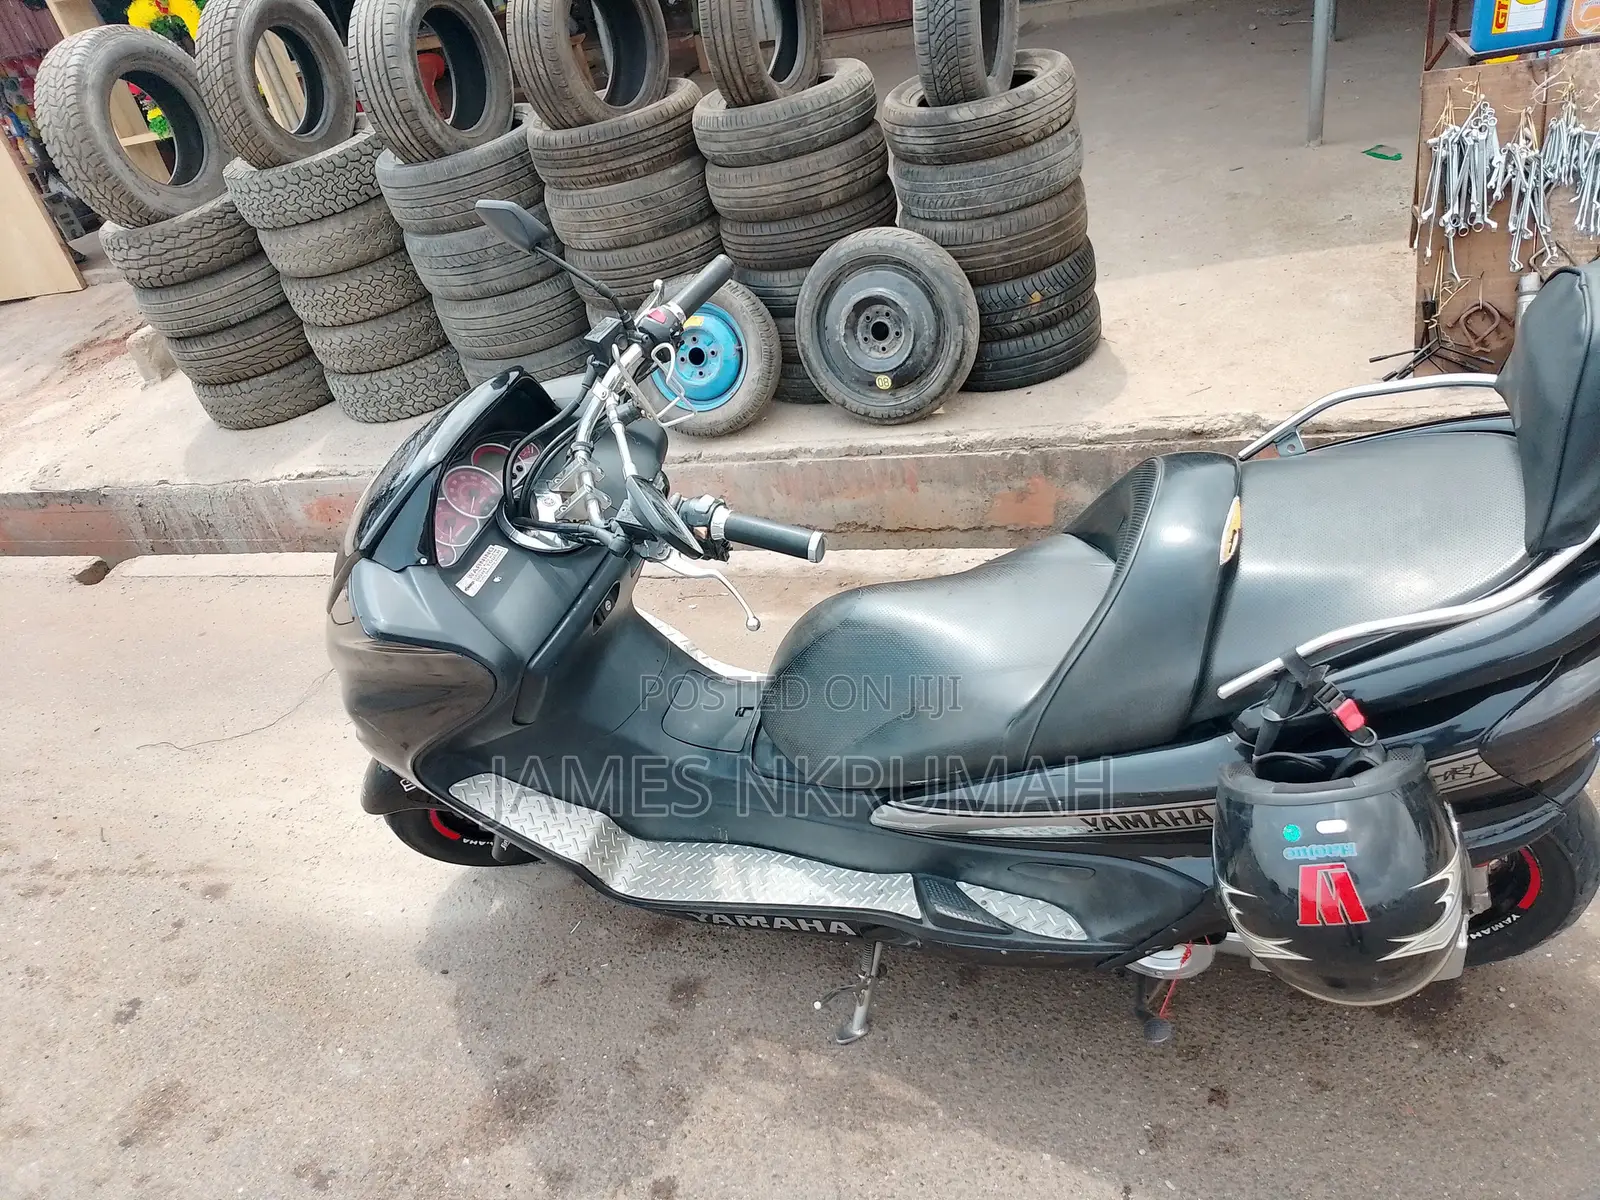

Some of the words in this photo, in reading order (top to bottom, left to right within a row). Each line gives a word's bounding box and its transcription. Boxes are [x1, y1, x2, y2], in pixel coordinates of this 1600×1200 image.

[1495, 0, 1508, 29] GT
[877, 377, 890, 388] 08
[1080, 808, 1214, 833] YAMAHA
[686, 912, 858, 936] YAMAHA
[1467, 913, 1522, 941] YAMAH
